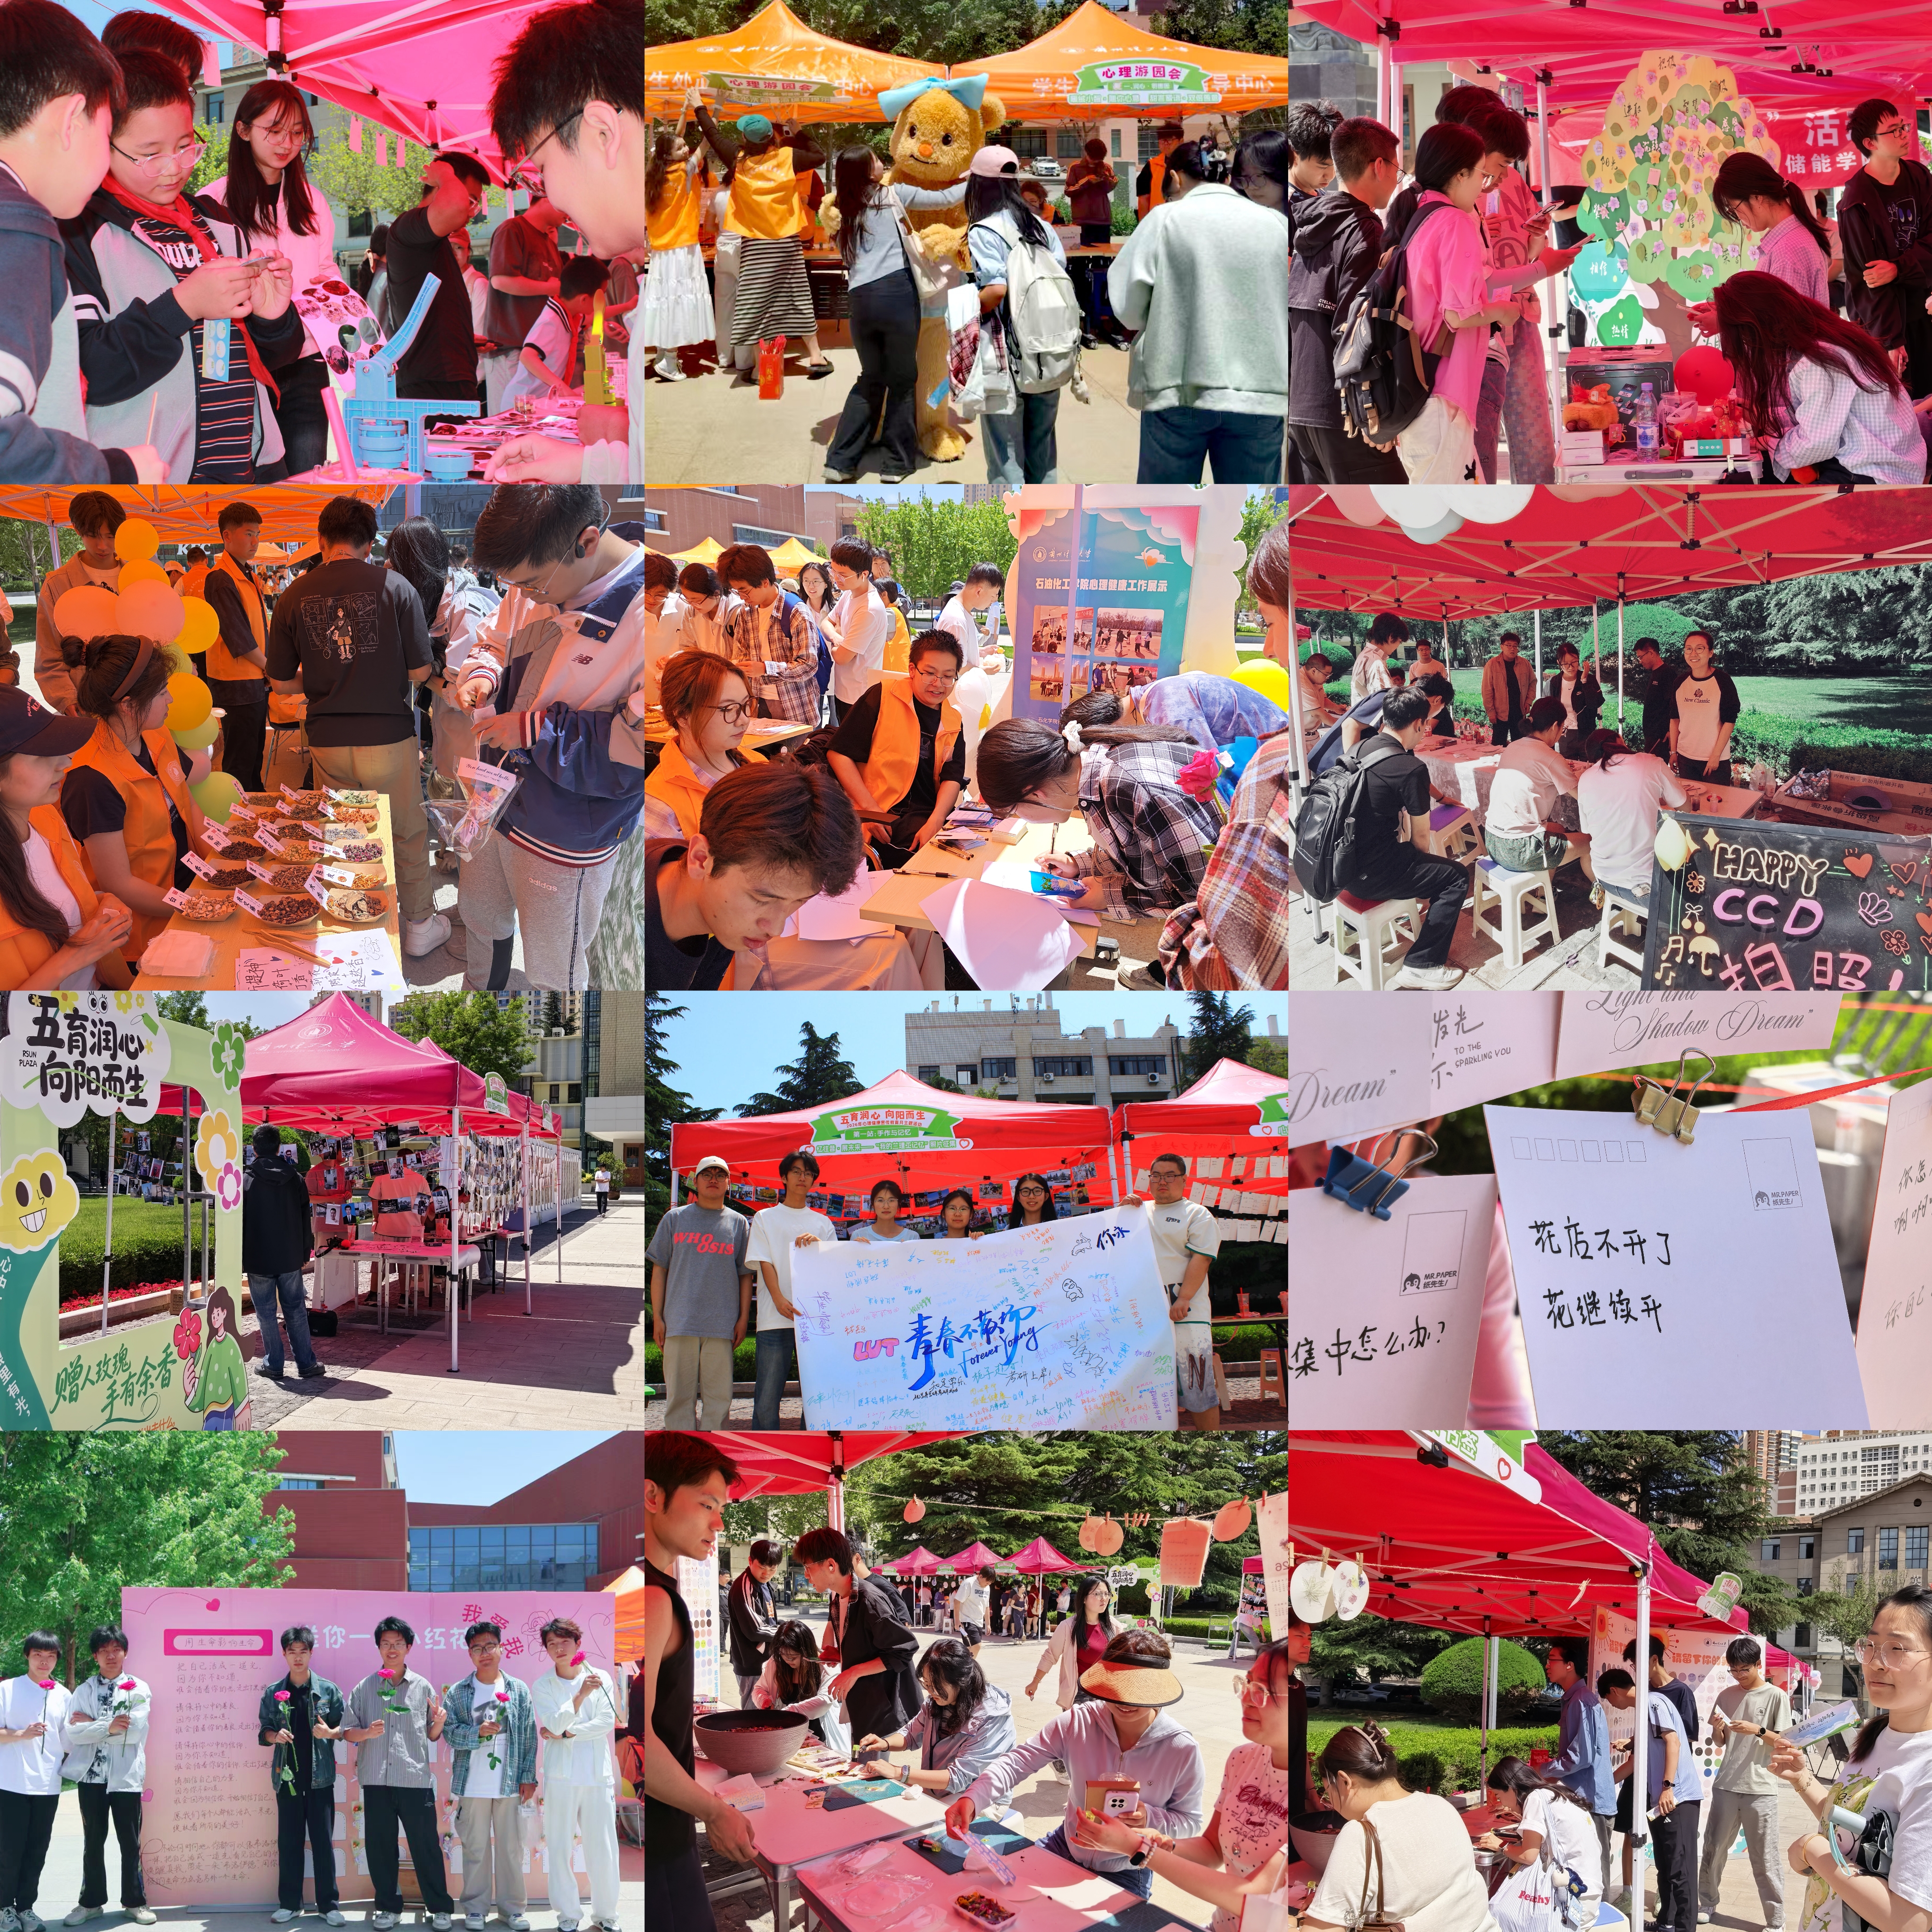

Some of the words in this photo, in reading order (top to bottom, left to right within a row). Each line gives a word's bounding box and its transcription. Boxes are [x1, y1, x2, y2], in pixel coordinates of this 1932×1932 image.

[1102, 65, 1182, 80] 心理游园会
[729, 78, 812, 91] 心理游园会
[1600, 156, 1618, 172] 阳光
[1590, 260, 1607, 275] 相信
[1318, 303, 1335, 311] KTLZNTC
[1611, 324, 1629, 339] 热情
[1049, 548, 1091, 558] 兰州理大学
[258, 835, 274, 849] 茉莉花
[312, 845, 331, 854] 玫瑰花
[186, 858, 202, 872] 丁香
[1714, 843, 1829, 897] HAPPY
[316, 870, 335, 879] 陈皮
[528, 877, 558, 891] adidas
[1713, 889, 1824, 935] CCD
[26, 993, 145, 1061] 五育润心
[1434, 1005, 1484, 1048] 发光
[1609, 1007, 1709, 1054] Shadow
[1454, 1047, 1465, 1058] TO
[1467, 1042, 1482, 1053] THE
[1495, 1047, 1511, 1059] YOU
[19, 1059, 37, 1067] PLAZA
[40, 1050, 149, 1108] 向阳而生
[841, 1110, 881, 1124] 五育润心
[885, 1109, 925, 1120] 向阳而生
[846, 1120, 923, 1128] 2026年心理健康宣传教育月主题活动
[929, 1140, 957, 1149] 照片征集
[1771, 1190, 1799, 1198] MR.PAPER
[1528, 1216, 1672, 1266] 花店不开了
[1424, 1270, 1457, 1280] MR.PAPER
[1543, 1289, 1663, 1334] 花继续开
[853, 1337, 900, 1362] LUT
[900, 1355, 908, 1381] 青春无畏
[49, 1343, 132, 1414] 赠人玫瑰
[101, 1342, 178, 1421] 手有余香
[929, 1376, 967, 1391] 知足常乐
[1006, 1367, 1051, 1387] 考研上岸!
[1111, 1570, 1133, 1578] 五育润心
[185, 1637, 254, 1648] 用生命影响生命
[1798, 1721, 1815, 1733] 五育润心
[1817, 1711, 1836, 1724] 向阳而生
[1518, 1890, 1550, 1905] Peachy
